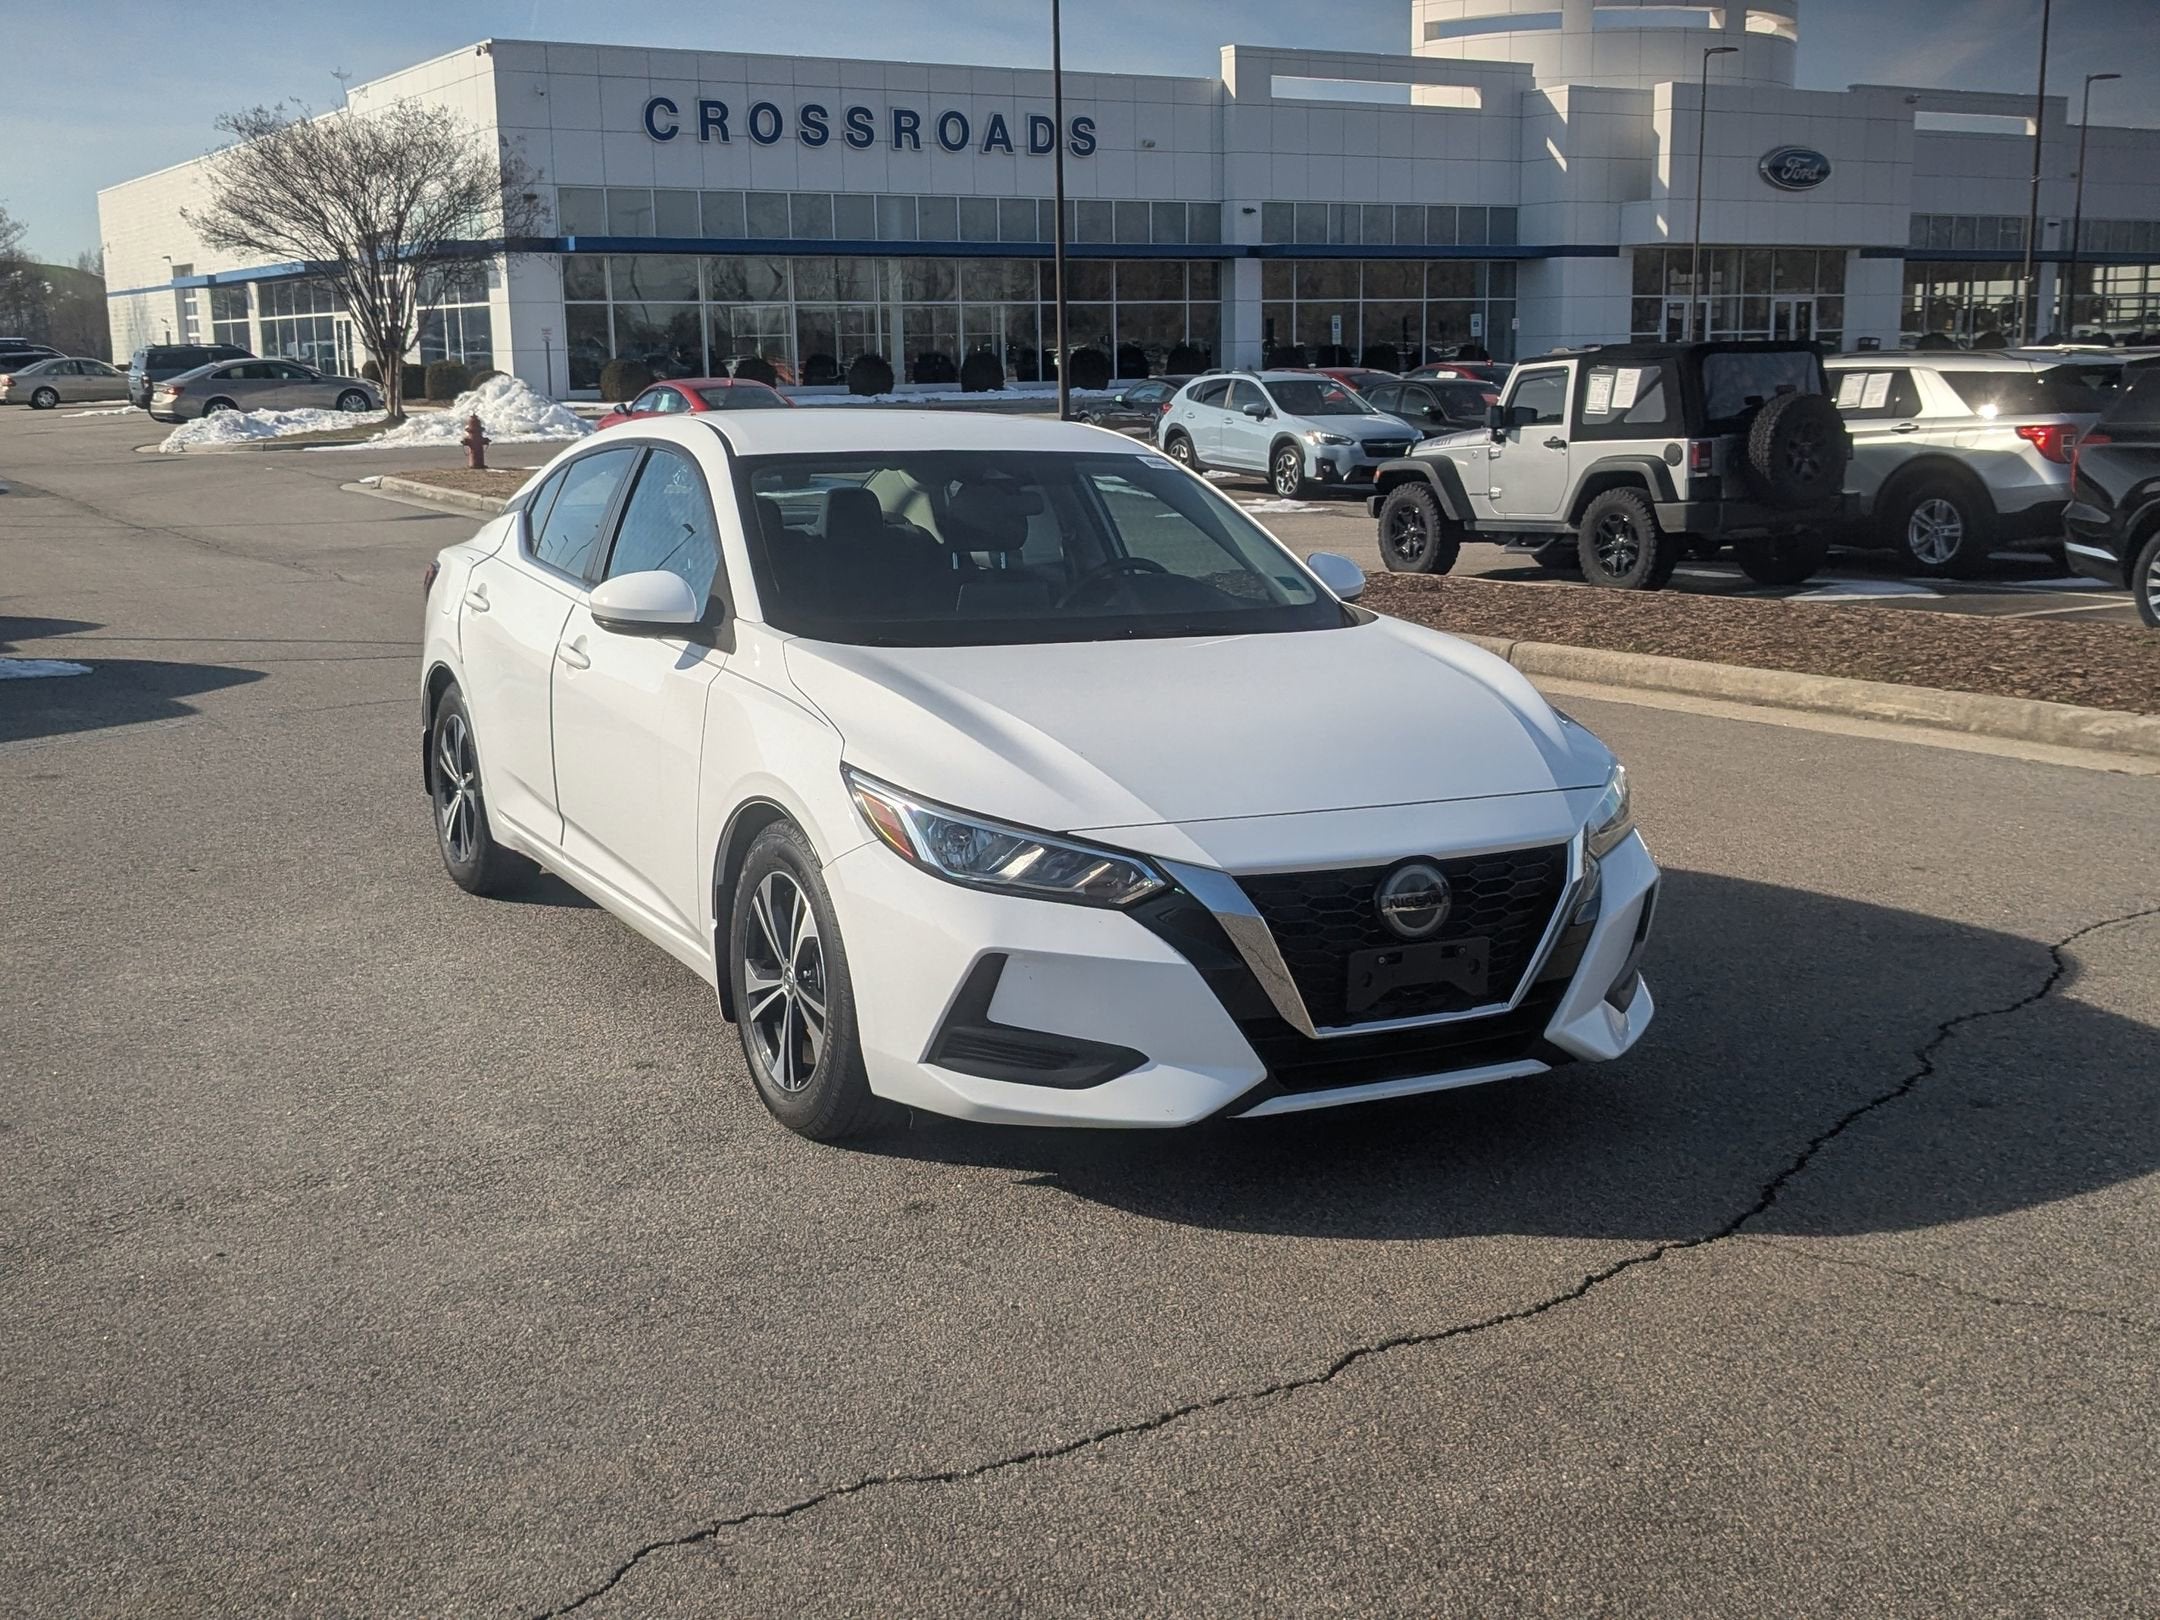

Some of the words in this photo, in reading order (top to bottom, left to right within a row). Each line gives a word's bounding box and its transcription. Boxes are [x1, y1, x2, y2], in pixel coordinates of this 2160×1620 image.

[643, 96, 1097, 157] CROSSROADS
[1781, 156, 1821, 180] Ford
[1389, 893, 1442, 909] NISSAN
